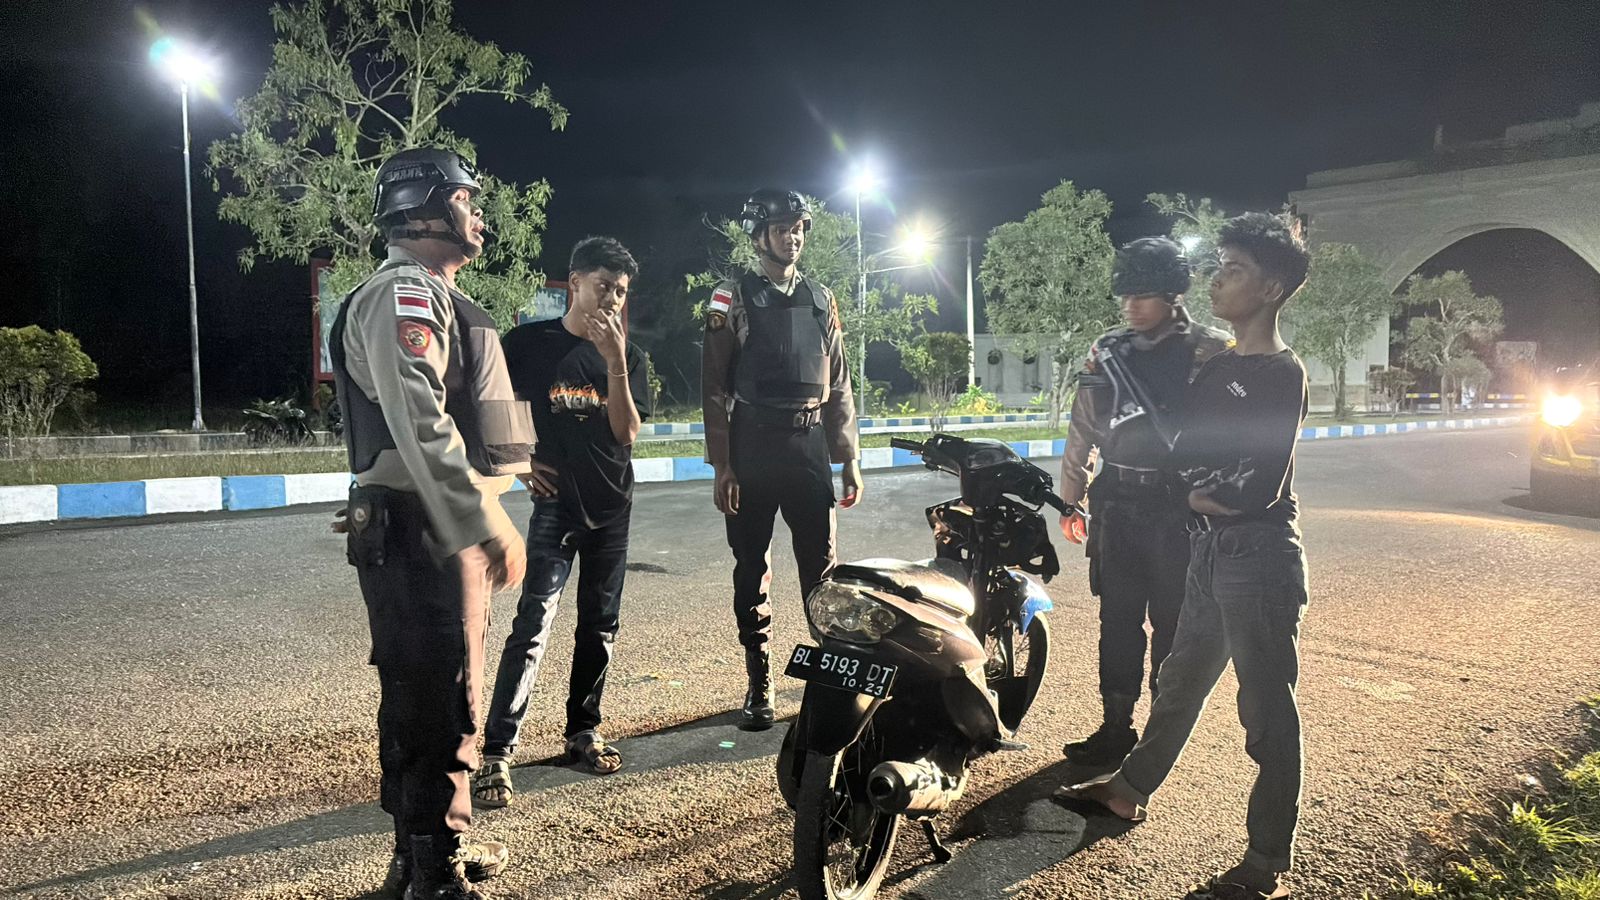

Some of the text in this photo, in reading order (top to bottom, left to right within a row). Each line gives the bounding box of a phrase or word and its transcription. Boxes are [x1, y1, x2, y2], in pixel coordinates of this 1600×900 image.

[793, 647, 893, 684] BL 5193 DT
